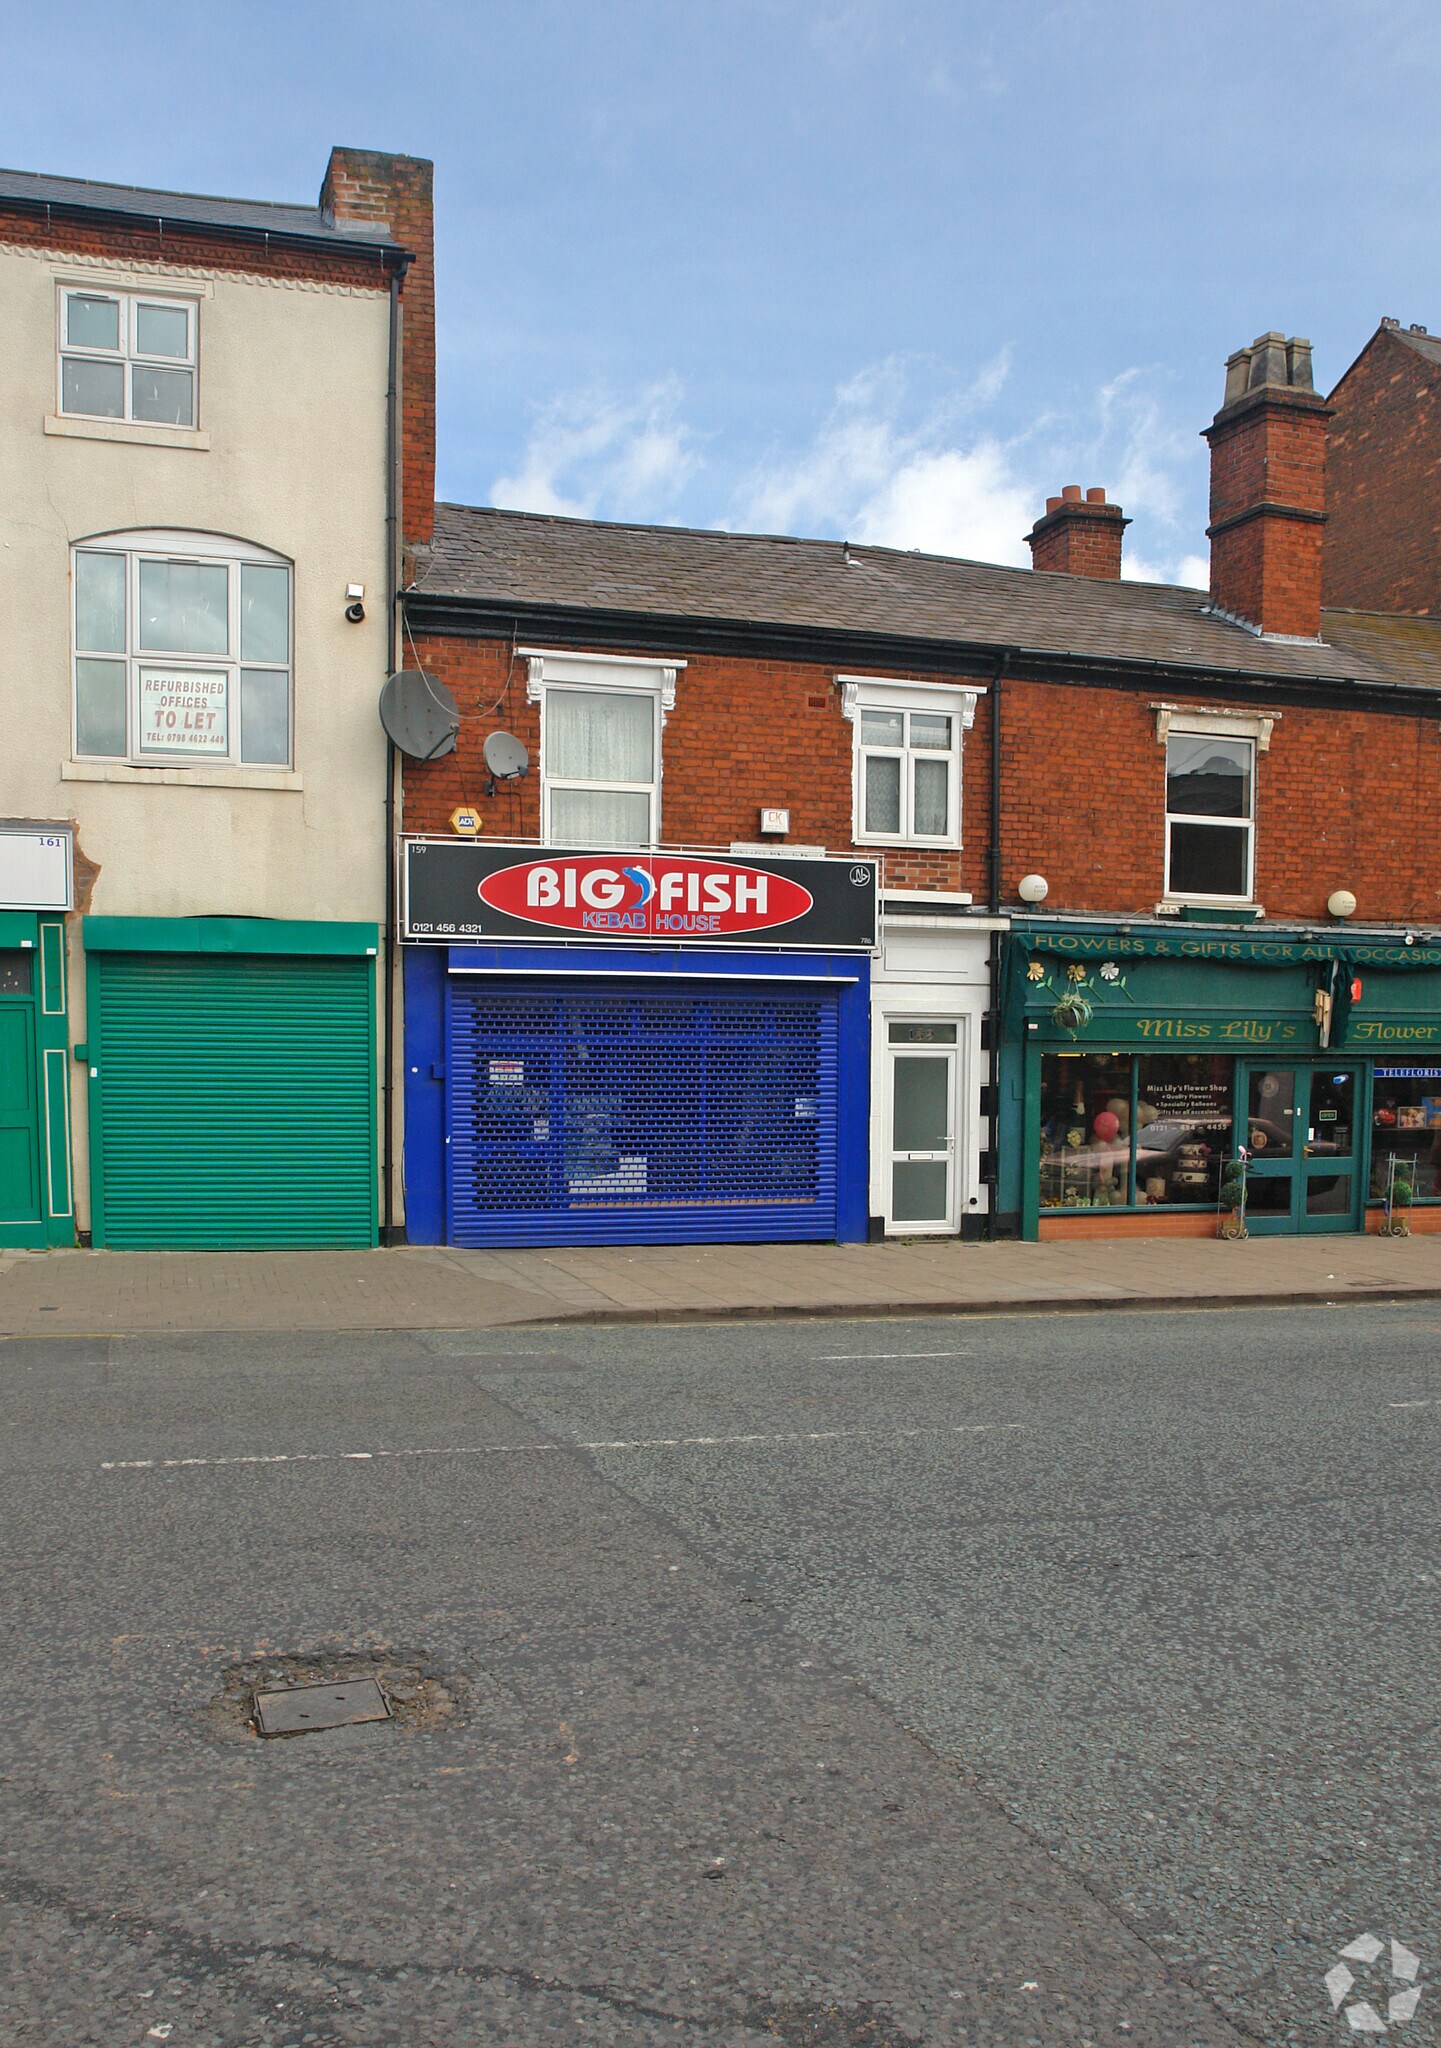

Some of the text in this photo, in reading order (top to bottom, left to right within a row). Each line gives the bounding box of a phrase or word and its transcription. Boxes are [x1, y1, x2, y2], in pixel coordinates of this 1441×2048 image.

[145, 680, 224, 694] REFURBISHED
[160, 696, 208, 708] OFFICES
[154, 710, 216, 729] TO LET
[147, 733, 164, 741] TEL:
[39, 837, 61, 847] 161
[412, 846, 427, 854] 159
[527, 866, 768, 914] BIG FISH
[412, 922, 482, 933] 0121 456 4321
[583, 912, 721, 931] KEBAB HOUSE
[1035, 935, 1145, 951] FLOWERS
[1155, 941, 1169, 952] &
[1181, 941, 1242, 955] GIFTS
[1252, 944, 1293, 957] FOR
[1302, 946, 1334, 958] ALL
[1136, 1019, 1439, 1043] Miss Lily's Flower
[1164, 1085, 1182, 1093] Lily's
[1209, 1084, 1228, 1092] Shop
